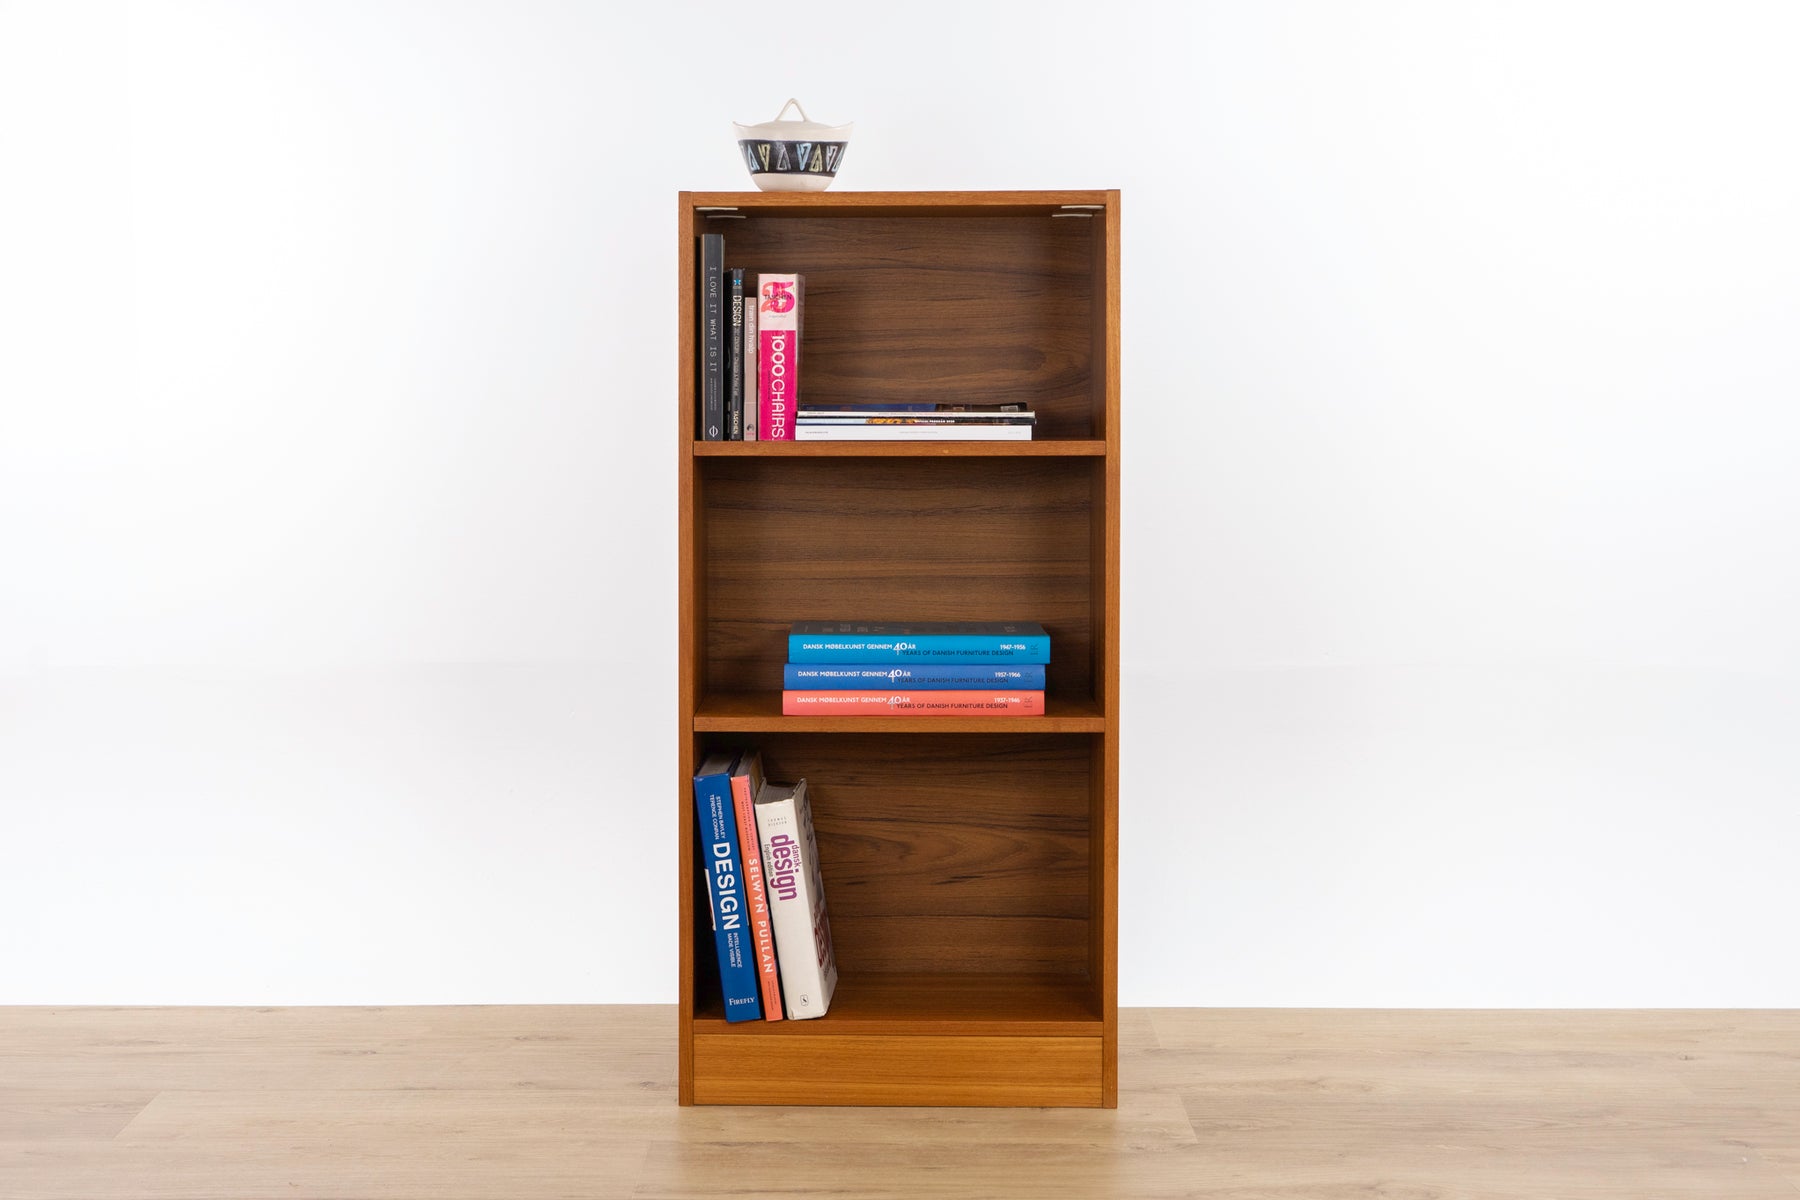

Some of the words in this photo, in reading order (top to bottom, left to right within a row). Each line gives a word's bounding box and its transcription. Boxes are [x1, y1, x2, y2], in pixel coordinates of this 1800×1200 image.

[710, 304, 717, 313] IT
[733, 295, 742, 327] DESIGN
[710, 347, 717, 357] IS
[771, 335, 785, 377] 1000
[710, 362, 717, 372] IT
[771, 379, 785, 438] CHAIRS
[893, 642, 908, 656] 40
[908, 642, 916, 650] ÅR
[887, 669, 902, 683] 40
[886, 696, 901, 710] 40
[715, 796, 723, 819] STEPHEN
[712, 817, 720, 840] CONRAN
[764, 843, 772, 861] English
[791, 844, 802, 868] dansk
[766, 860, 774, 878] edition
[770, 834, 800, 901] design
[713, 842, 741, 930] DESIGN
[748, 858, 765, 913] SELWYN
[757, 920, 774, 973] PULLAN
[733, 932, 742, 968] INTELLIGENCE
